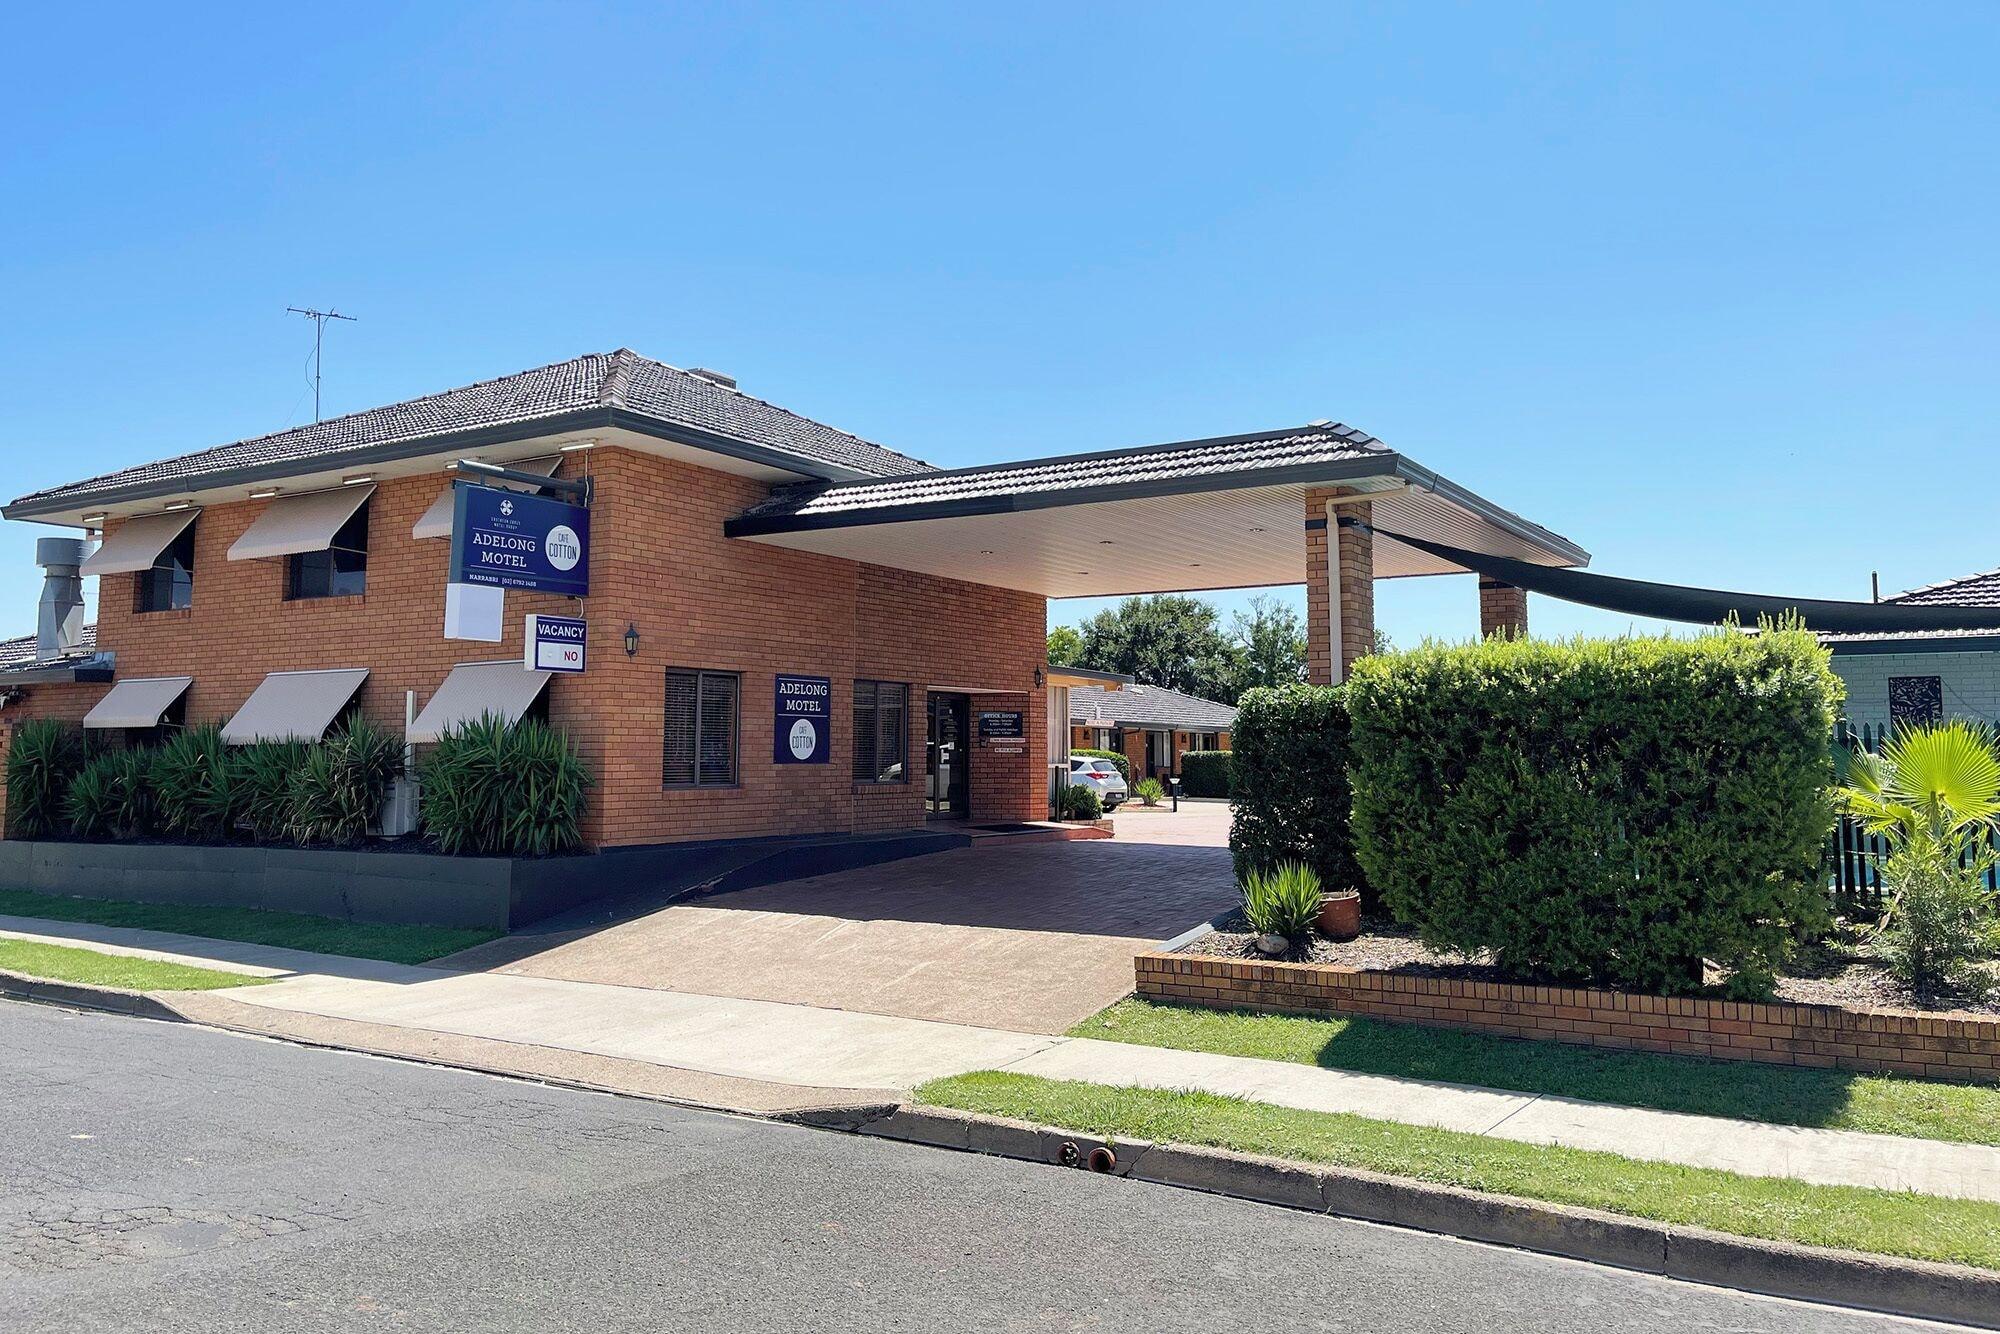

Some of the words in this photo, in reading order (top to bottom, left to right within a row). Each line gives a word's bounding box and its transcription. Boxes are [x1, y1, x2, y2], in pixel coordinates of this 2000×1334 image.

[473, 532, 536, 552] ADELONG
[549, 542, 577, 561] COTTON
[481, 551, 527, 568] MOTEL
[469, 574, 499, 583] NARRABRI
[538, 623, 585, 638] VACANCY
[564, 651, 578, 662] NO
[779, 683, 828, 696] ADELONG
[786, 700, 821, 712] MOTEL
[792, 735, 813, 749] COTTON
